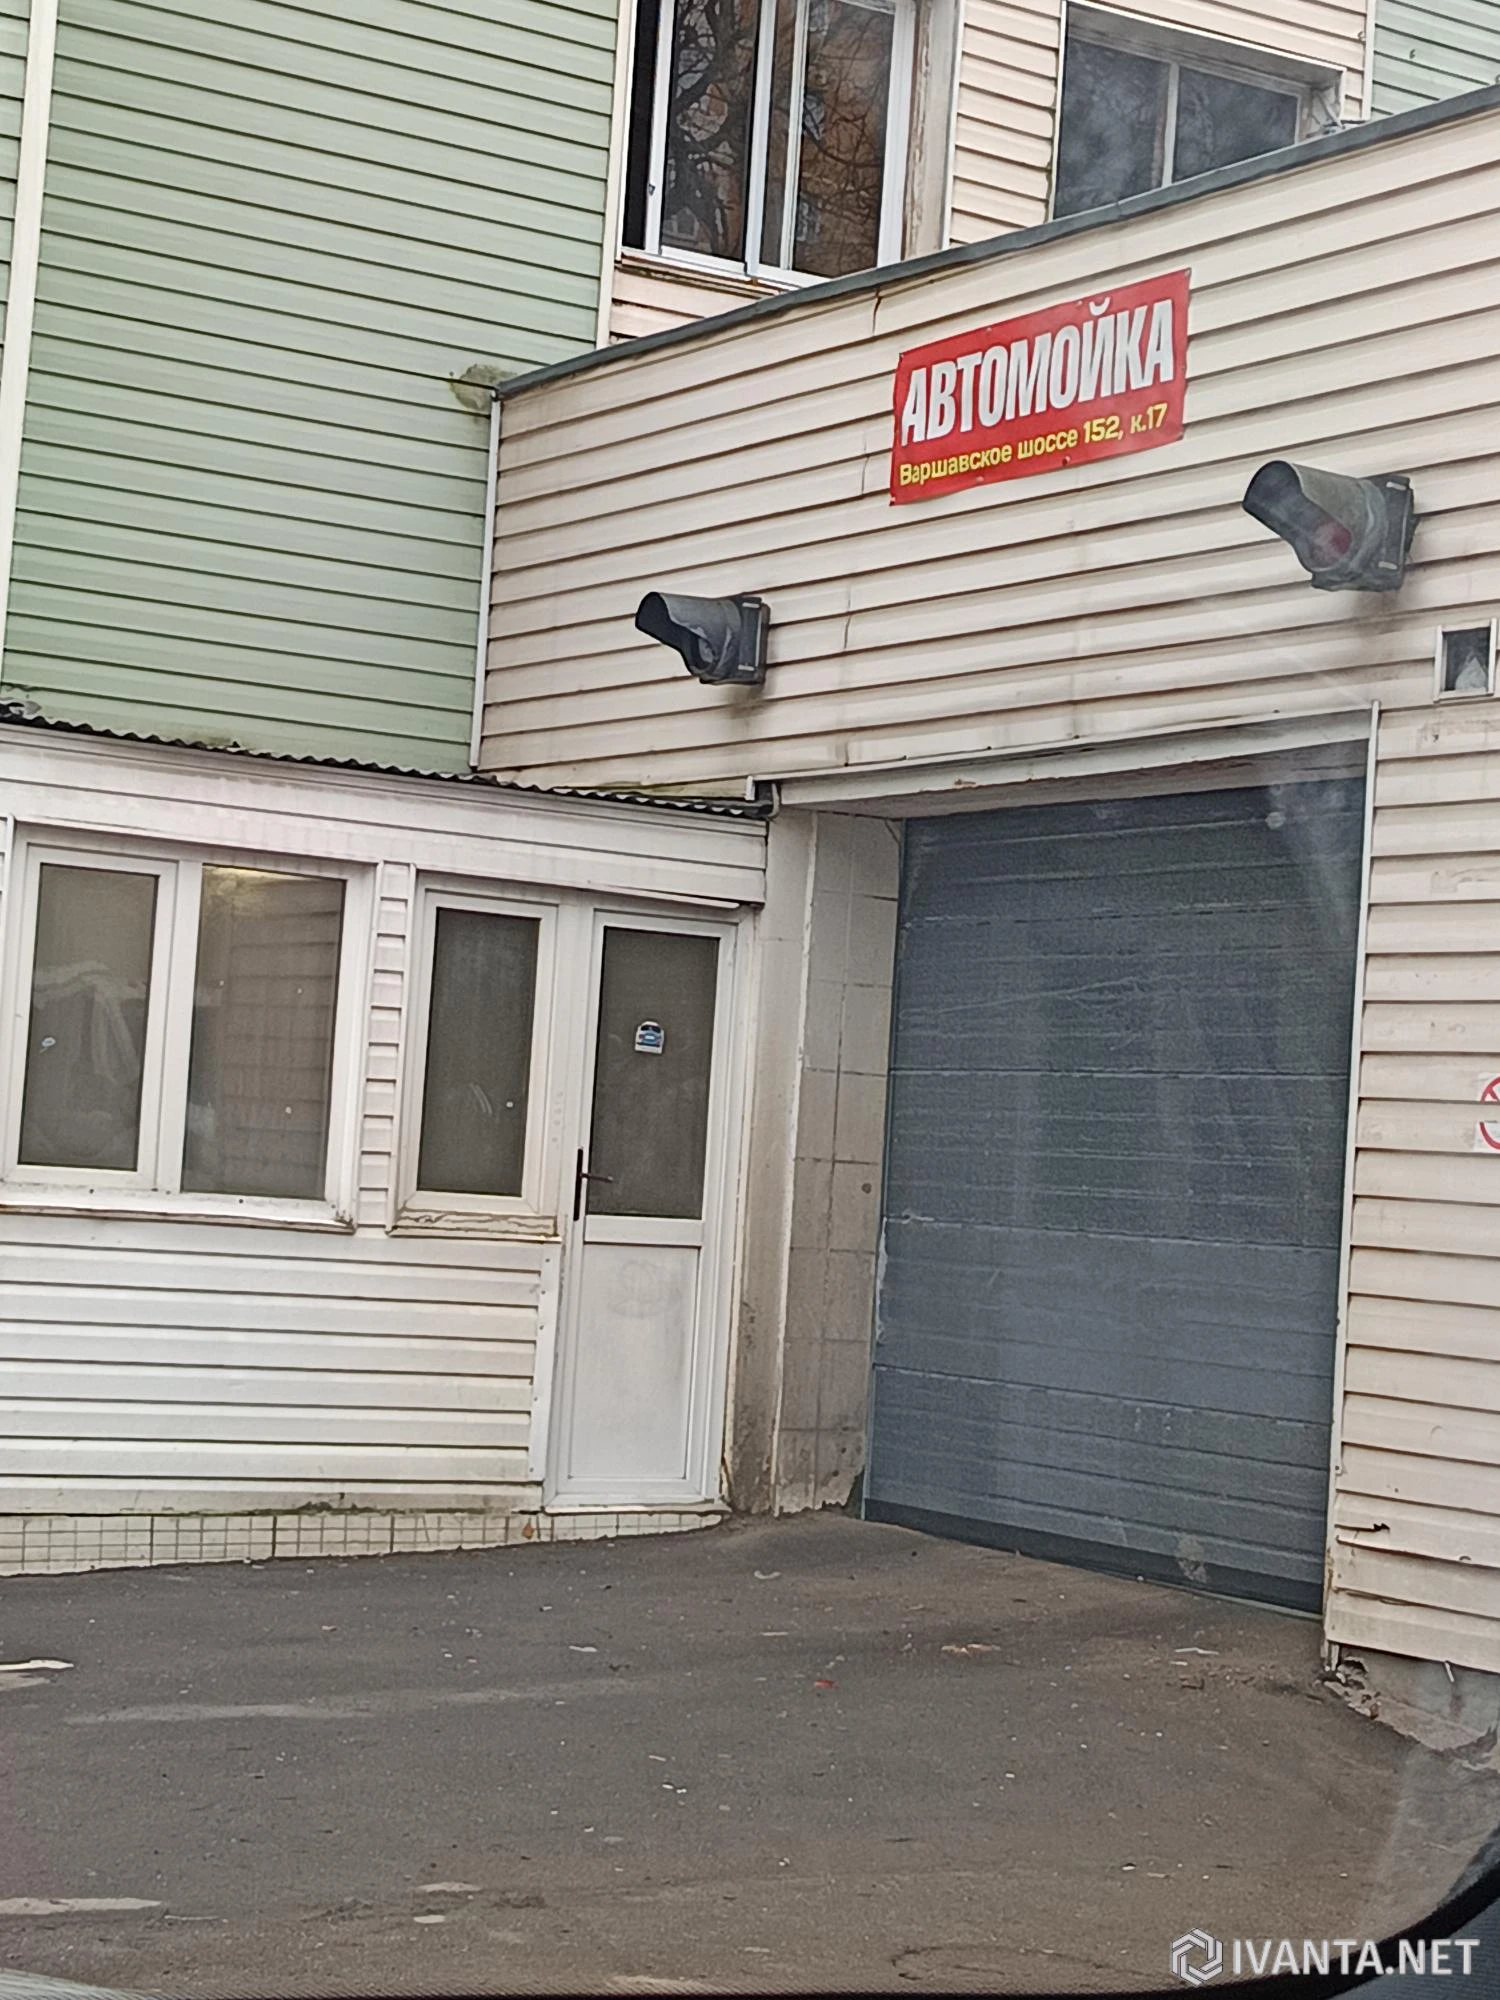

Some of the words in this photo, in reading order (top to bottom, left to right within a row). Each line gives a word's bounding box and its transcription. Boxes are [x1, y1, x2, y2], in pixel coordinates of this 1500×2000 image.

[901, 297, 1174, 447] АВТОМОЙКА
[900, 445, 1012, 486] Варшавское
[1017, 428, 1078, 459] шоссе
[1083, 415, 1123, 444] 152,
[1130, 402, 1168, 435] к.17
